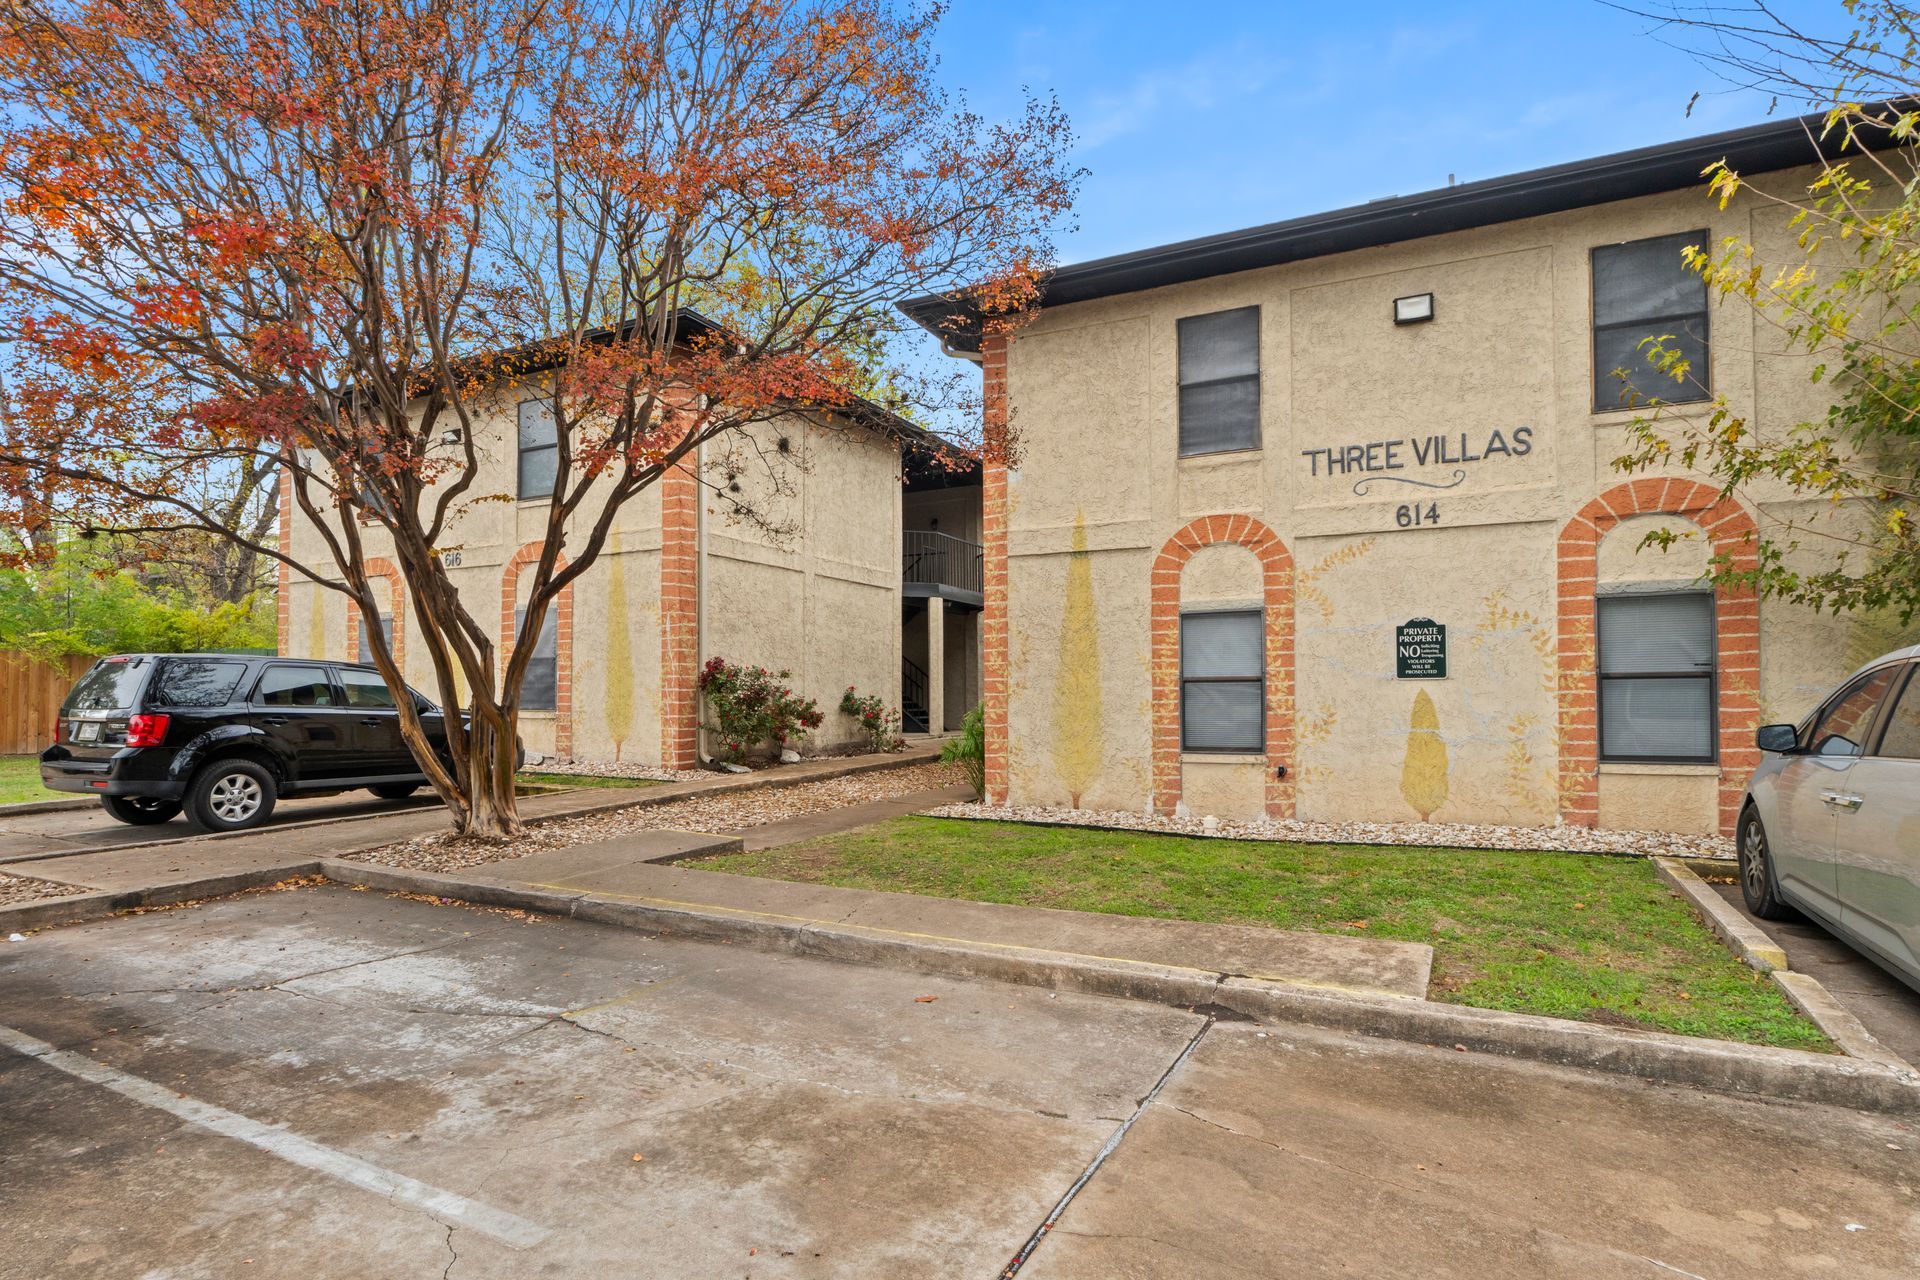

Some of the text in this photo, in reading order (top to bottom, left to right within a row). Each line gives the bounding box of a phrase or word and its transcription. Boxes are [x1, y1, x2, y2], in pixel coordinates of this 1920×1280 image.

[1302, 426, 1533, 476] THREE VILLAS
[1396, 501, 1440, 527] 614
[445, 552, 462, 567] 616
[1403, 627, 1439, 635] PRIVATE
[1399, 634, 1443, 643] PROPERTY
[1399, 645, 1420, 658] NO
